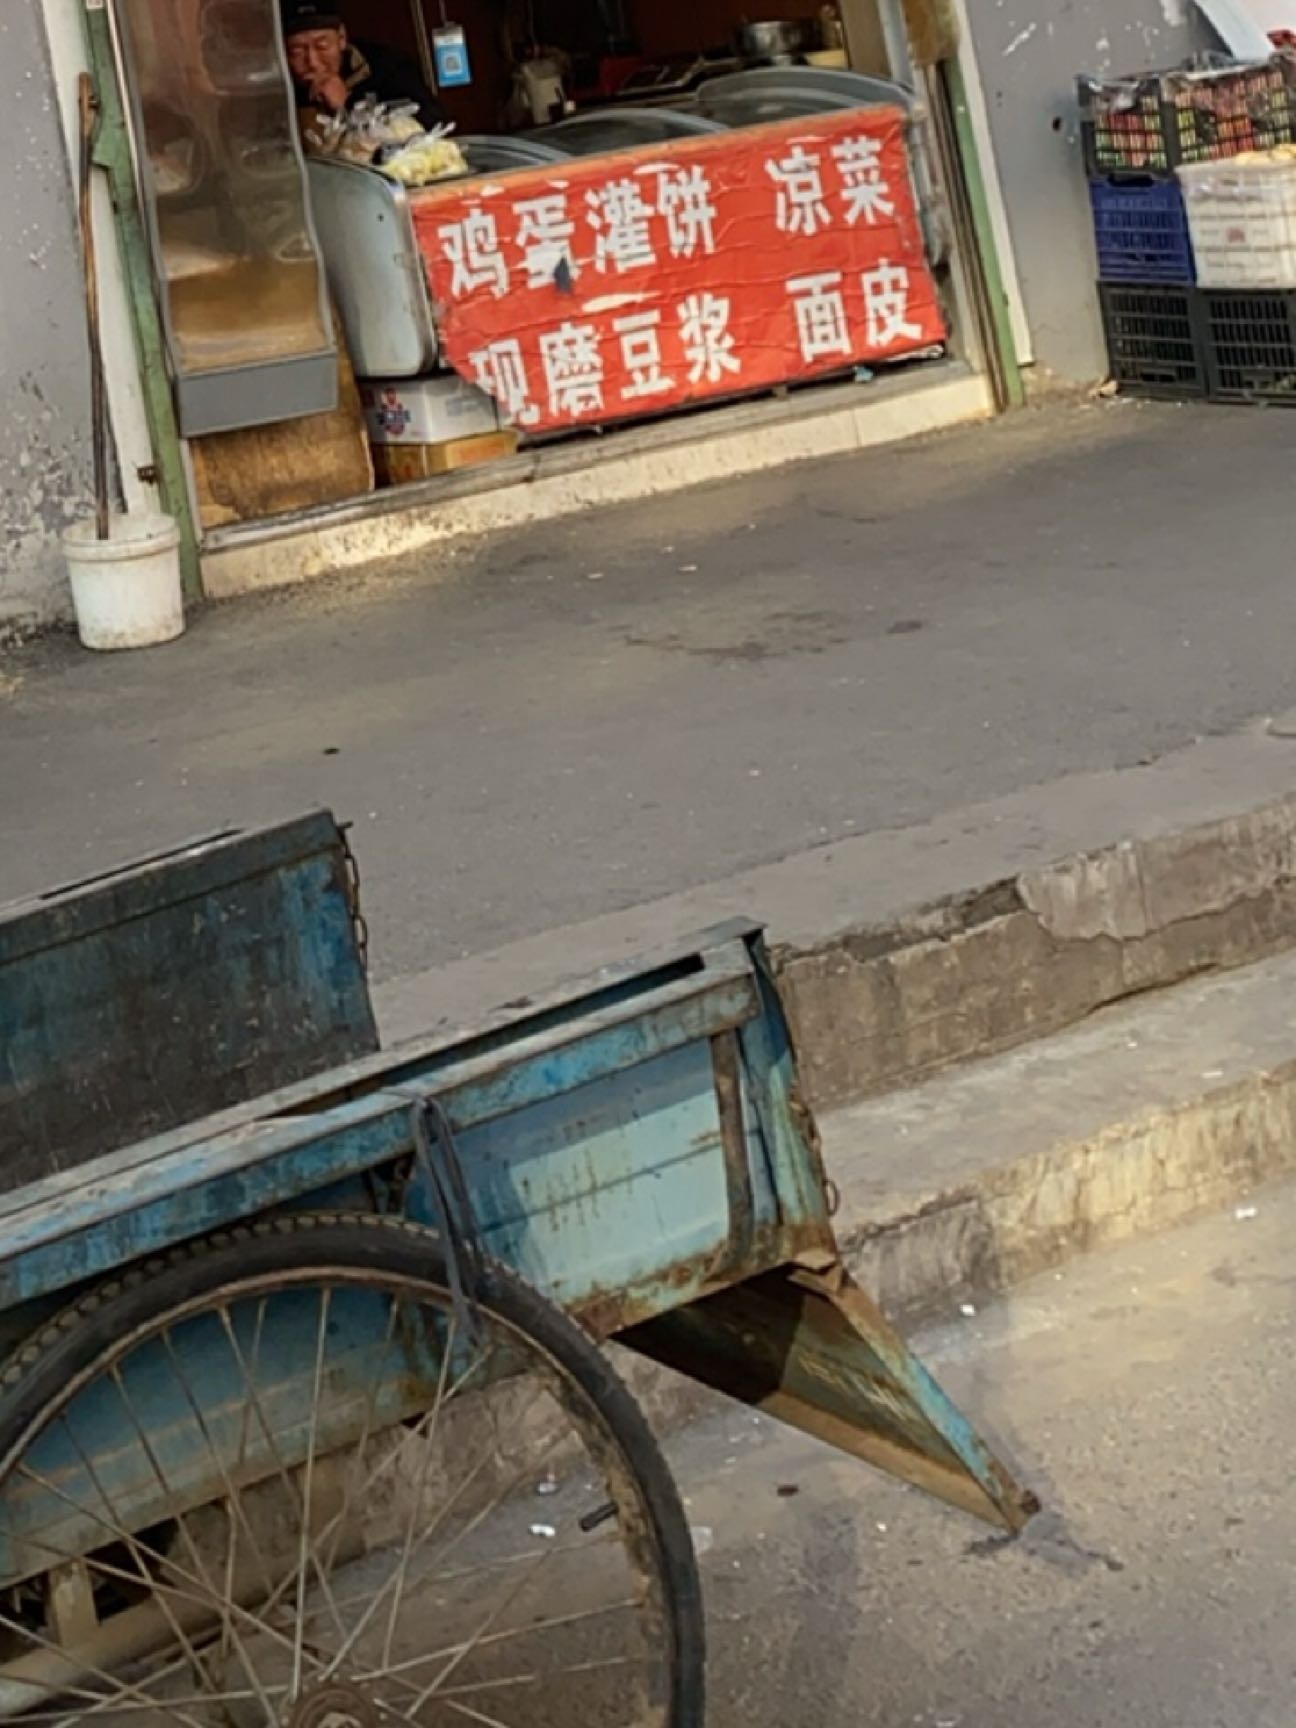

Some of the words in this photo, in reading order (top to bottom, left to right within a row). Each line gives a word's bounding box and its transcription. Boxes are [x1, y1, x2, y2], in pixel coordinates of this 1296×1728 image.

[437, 164, 717, 300] 鸡蛋灌饼
[766, 135, 896, 236] 凉菜
[786, 258, 923, 364] 面皮
